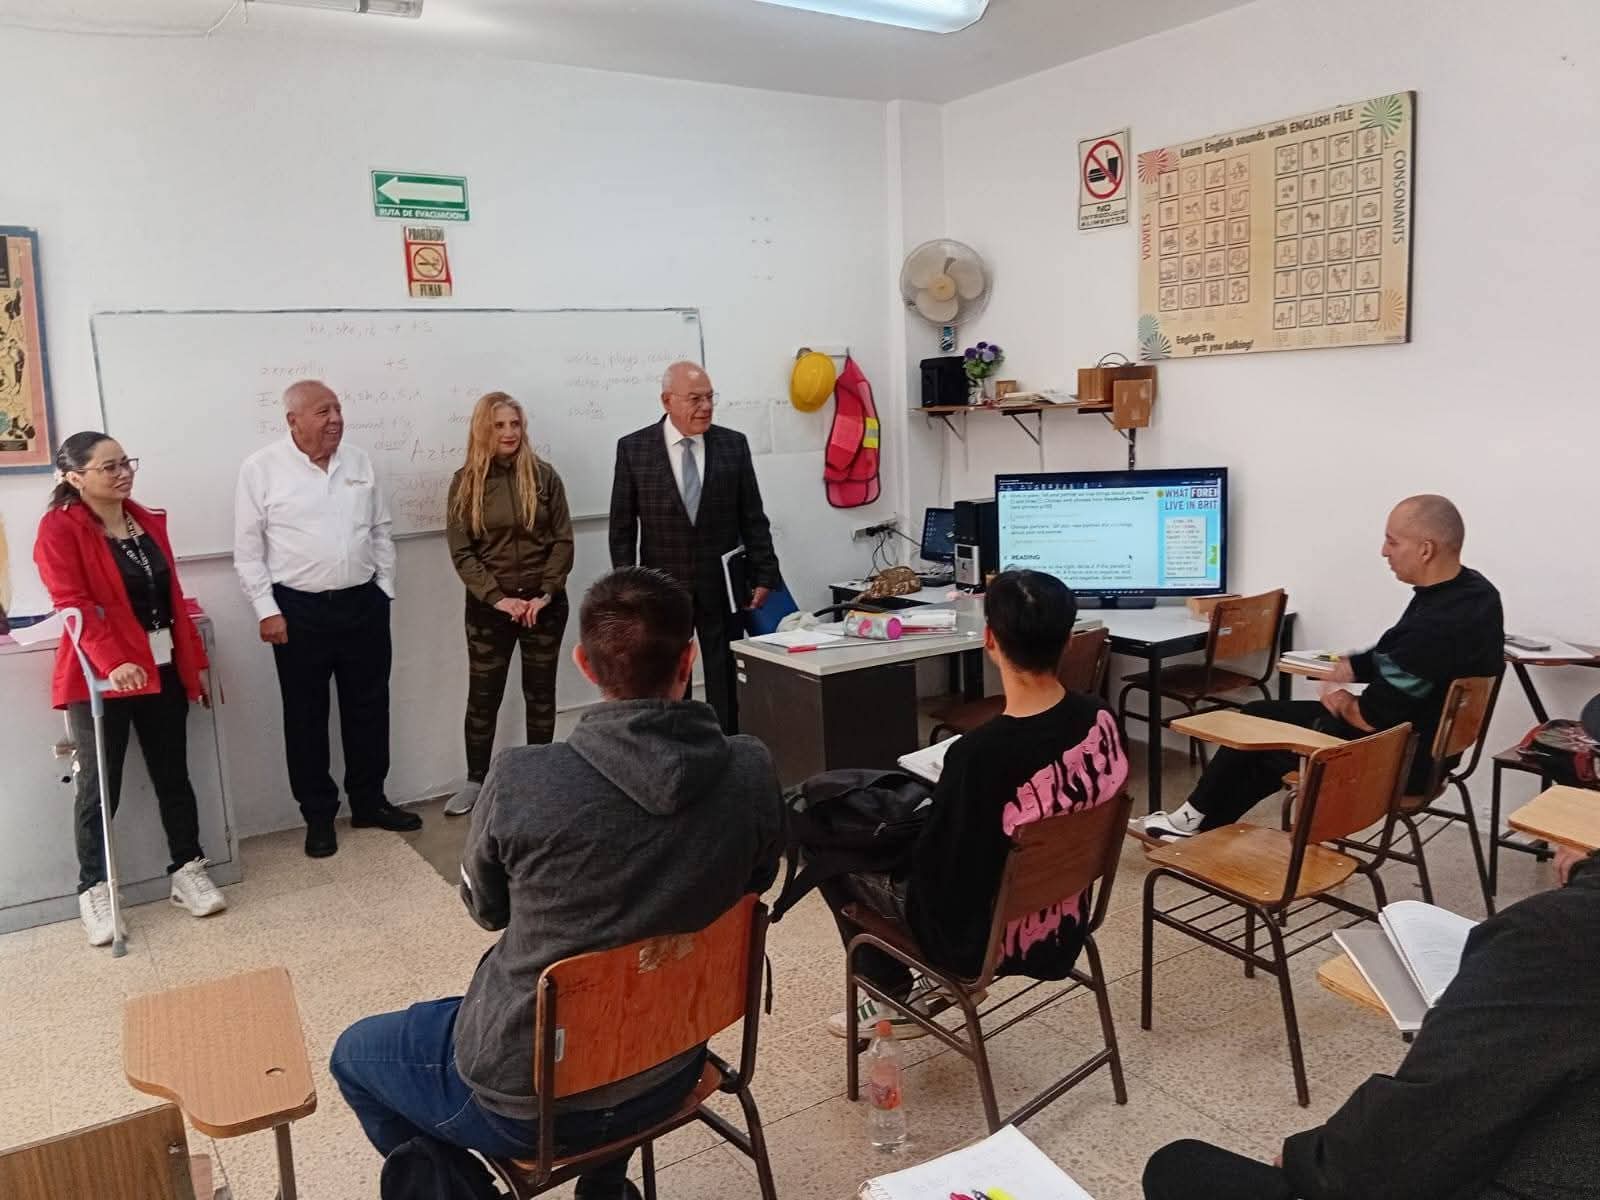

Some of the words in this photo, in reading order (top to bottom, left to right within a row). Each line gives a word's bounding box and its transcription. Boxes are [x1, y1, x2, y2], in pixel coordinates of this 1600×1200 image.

[1180, 146, 1203, 158] Learn
[1205, 138, 1234, 153] English
[1235, 131, 1265, 146] sounds
[1268, 125, 1287, 138] with
[1289, 114, 1331, 133] ENGLISH
[1333, 108, 1354, 122] FILE
[1392, 150, 1406, 245] CONSONANTS
[379, 209, 401, 217] RUTA
[402, 209, 413, 217] DE
[1096, 204, 1111, 212] NO
[1081, 216, 1126, 227] ALIMENTOS
[407, 227, 445, 241] PROHIBIDO
[1142, 214, 1152, 260] VOWELS
[419, 284, 443, 296] FUMAR
[1175, 333, 1201, 346] English
[1202, 332, 1216, 342] File
[1165, 488, 1189, 497] WHAT
[1165, 501, 1186, 510] LIVE
[1186, 501, 1196, 509] IN
[1197, 500, 1217, 509] BRIT
